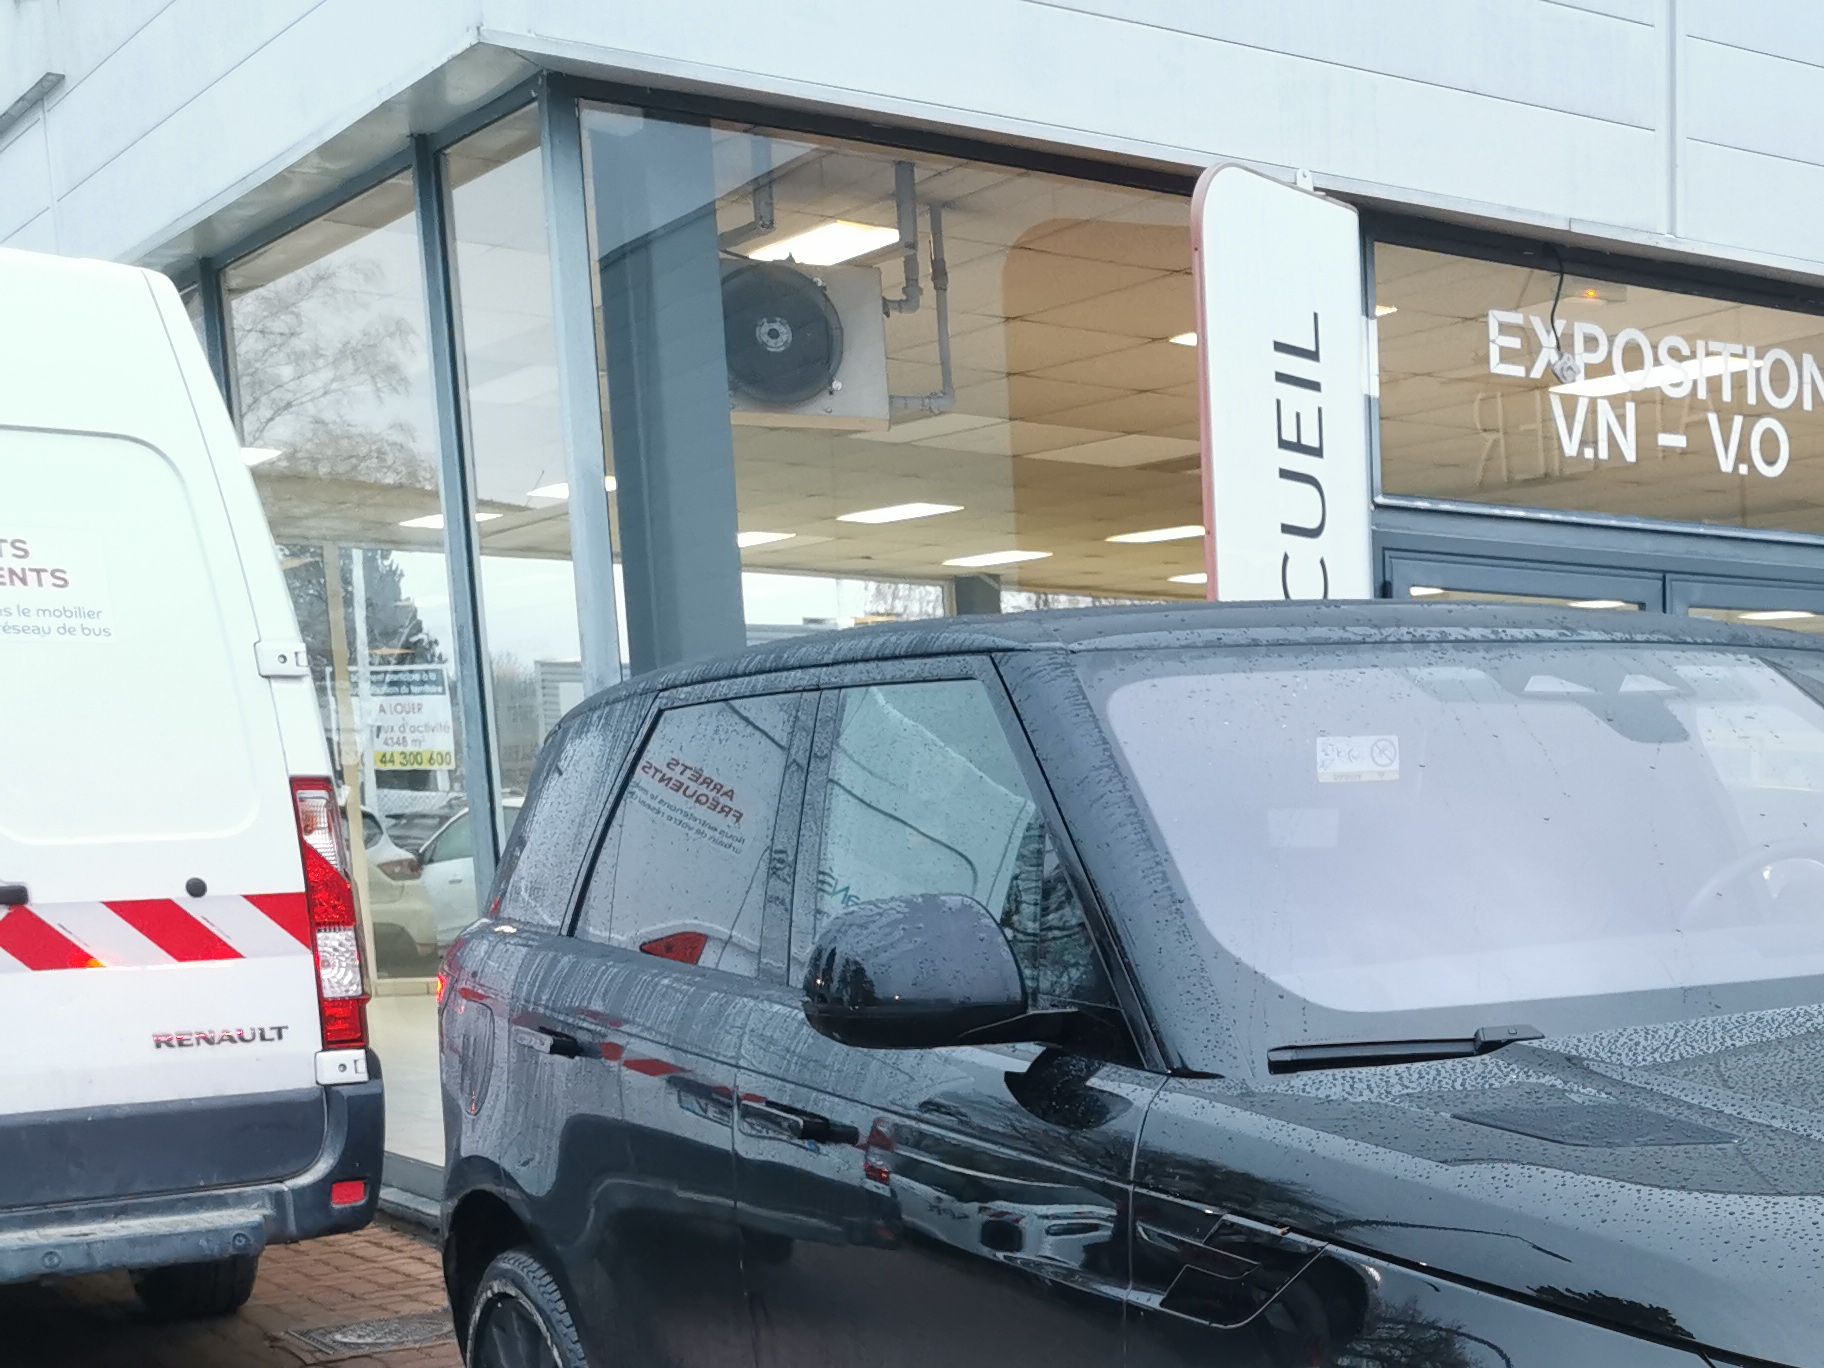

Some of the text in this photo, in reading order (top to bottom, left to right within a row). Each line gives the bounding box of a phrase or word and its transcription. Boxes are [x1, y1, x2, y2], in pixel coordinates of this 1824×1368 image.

[17, 604, 31, 617] le
[36, 605, 103, 619] mobilier
[0, 621, 112, 638] éseau de bus
[153, 1025, 289, 1049] RENAULT
